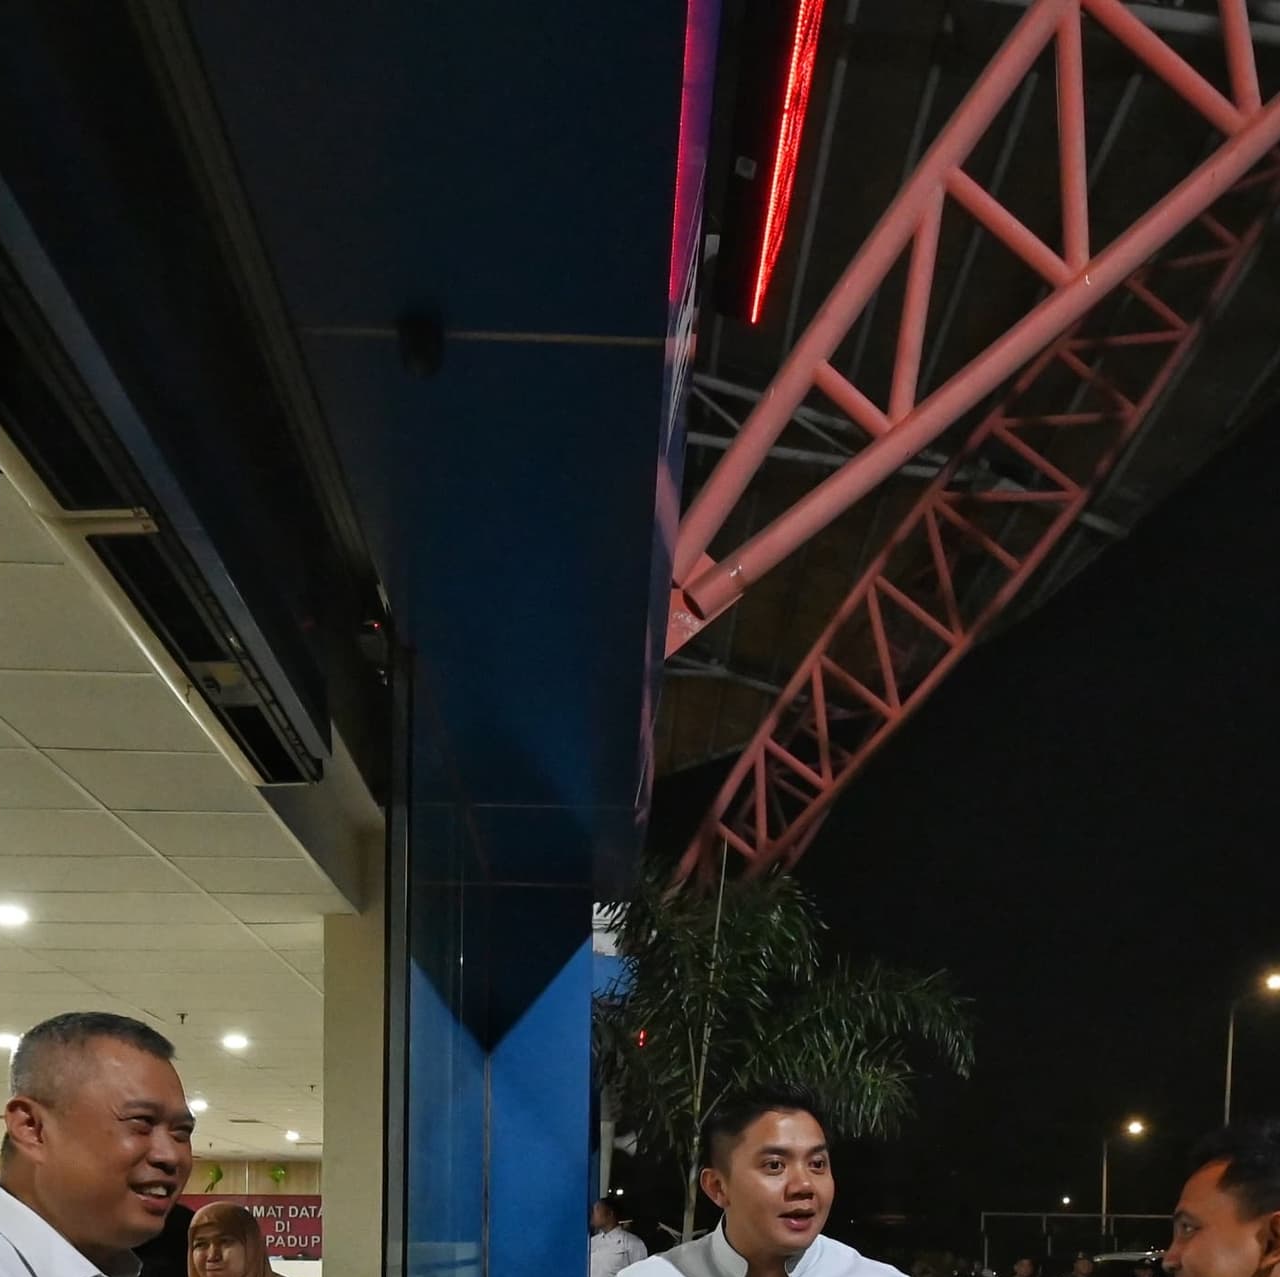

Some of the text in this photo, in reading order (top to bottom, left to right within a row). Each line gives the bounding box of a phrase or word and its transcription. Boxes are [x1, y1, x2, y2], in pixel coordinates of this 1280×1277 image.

[244, 1205, 284, 1218] MAT
[275, 1220, 290, 1233] DI
[265, 1235, 308, 1248] PADU
